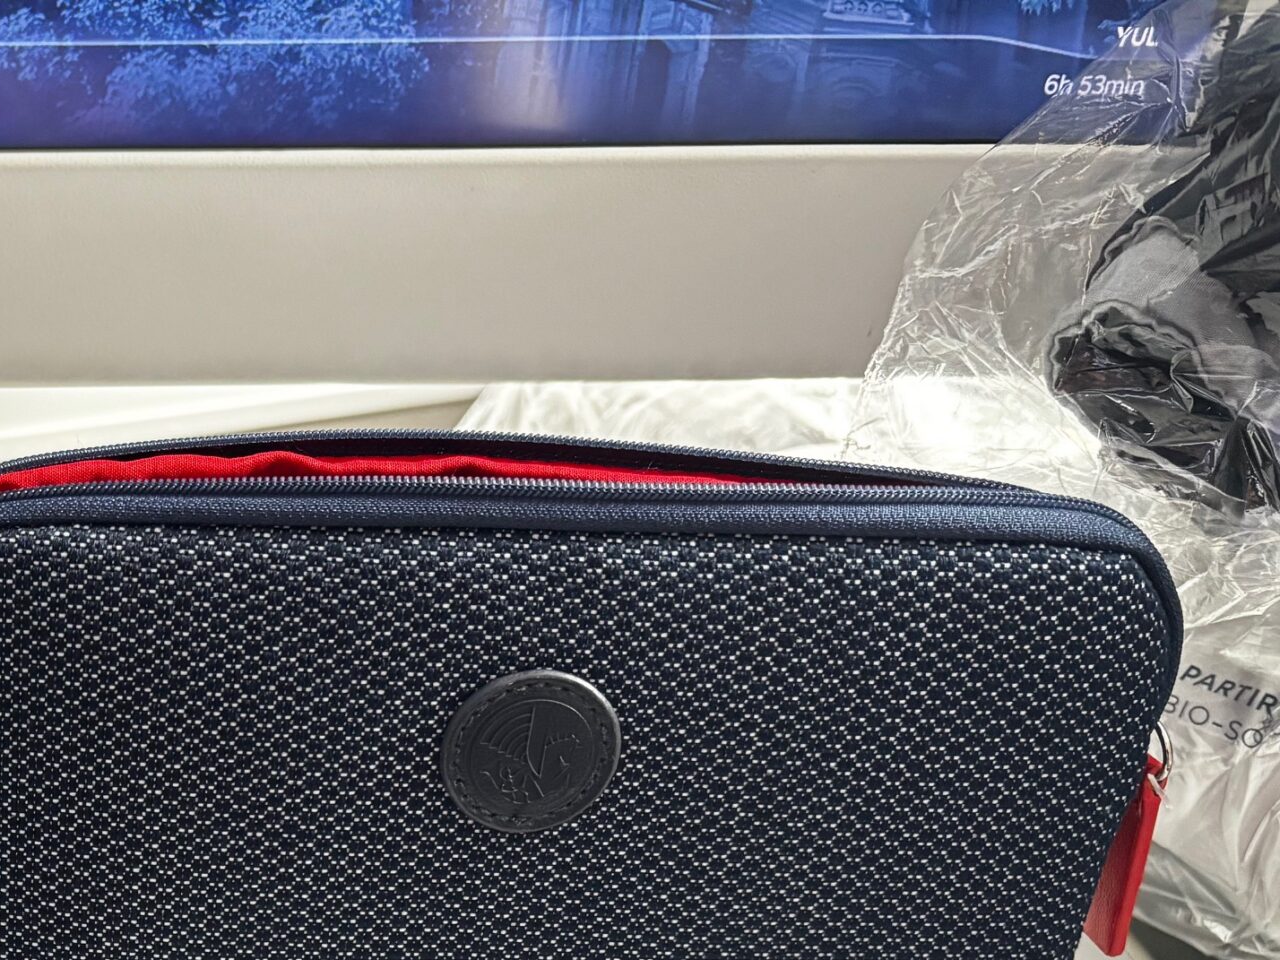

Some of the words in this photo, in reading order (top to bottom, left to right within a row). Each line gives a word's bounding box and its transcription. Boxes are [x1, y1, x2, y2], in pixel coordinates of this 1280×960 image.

[1117, 26, 1158, 48] YUL
[1044, 74, 1073, 96] 6h
[1077, 74, 1145, 97] 53min
[1179, 665, 1280, 717] PARTIR
